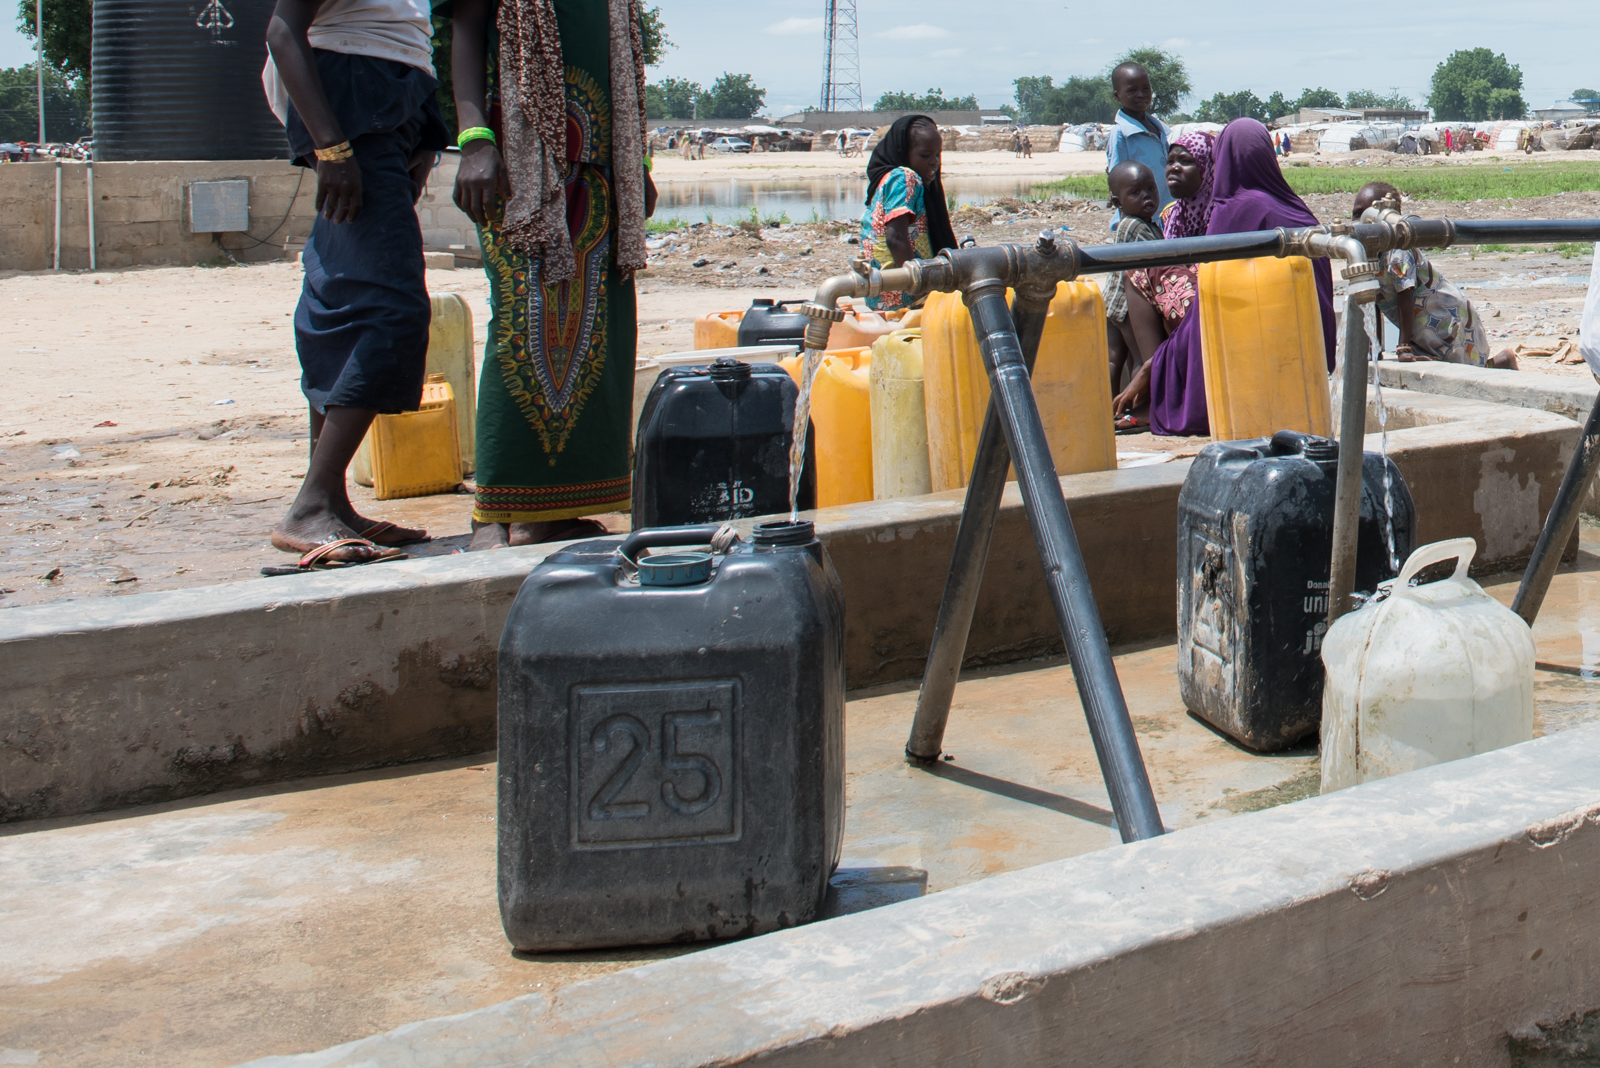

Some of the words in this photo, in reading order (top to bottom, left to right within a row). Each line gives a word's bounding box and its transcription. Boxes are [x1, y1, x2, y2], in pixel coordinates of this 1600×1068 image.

[1303, 590, 1329, 613] uni
[1303, 622, 1327, 655] ji
[588, 710, 722, 820] 25
